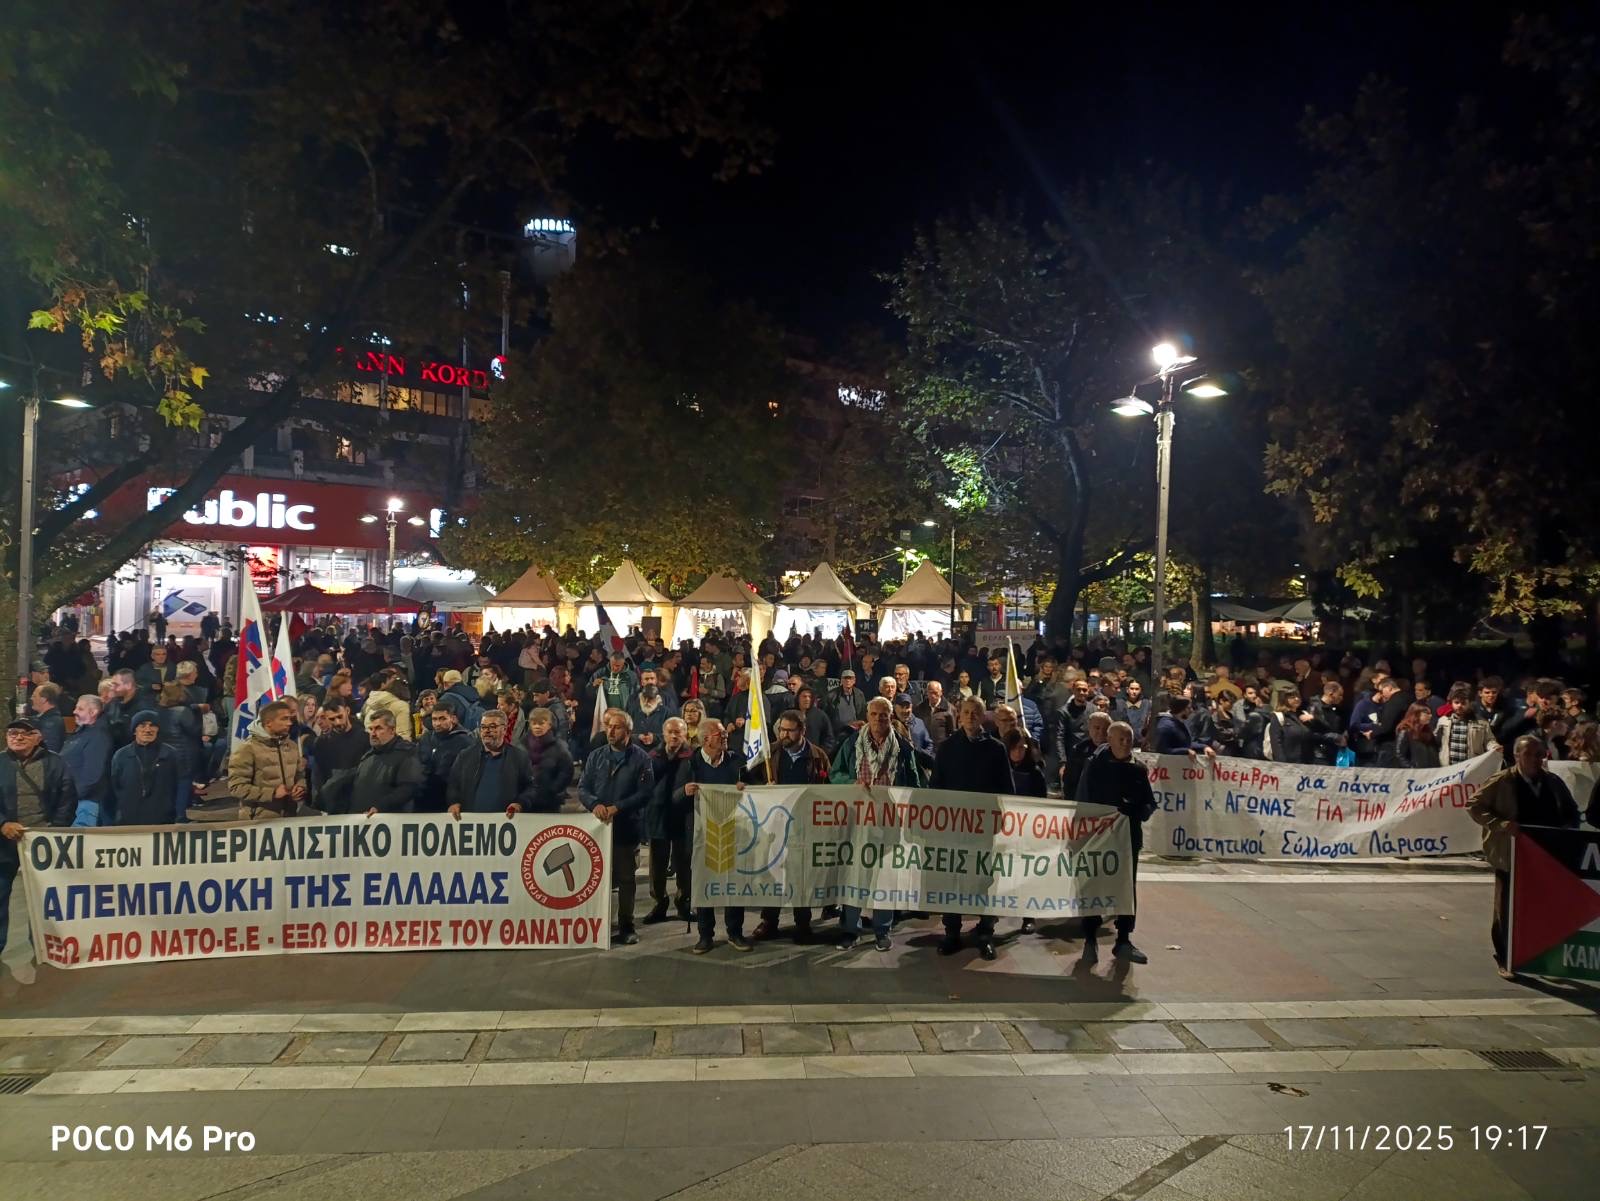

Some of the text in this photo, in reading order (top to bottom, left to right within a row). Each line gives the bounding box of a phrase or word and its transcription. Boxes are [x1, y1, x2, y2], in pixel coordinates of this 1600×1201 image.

[1183, 767, 1204, 781] του
[1296, 775, 1327, 791] για
[1339, 775, 1390, 794] πάντα
[812, 800, 848, 826] ΕΞΩ
[854, 801, 876, 827] ΤΑ
[992, 809, 1028, 837] ΤΟΥ
[1225, 790, 1296, 817] ΑΓΩΝΑΣ
[1317, 798, 1343, 823] ΓΙΑ
[1353, 798, 1386, 822] ΤΗΝ
[1393, 783, 1481, 815] ΑΝΑΤΡΟΠ
[31, 822, 517, 871] ΟΧΙ ΣΤΟΝ ΙΜΠΕΡΙΑΛΙΣΤΙΚΟ ΠΟΛΕΜΟ
[566, 828, 598, 854] ΚΕΝΤΡΟ
[812, 841, 1119, 877] ΕΞΩ ΟΙ ΒΑΣΕΙΣ ΚΑΙ ΤΟ ΝΑΤΟ
[1172, 826, 1449, 858] Φοιτητικοί Σύλλογοι Λάρισας
[43, 872, 509, 921] ΑΠΕΜΠΛΟΚΗ ΤΗΣ ΕΛΛΑΔΑΣ
[576, 867, 600, 902] ΛΑΡΙΣΑΣ
[815, 886, 918, 904] ΕΠΙΤΡΟΠΗ
[926, 890, 1018, 910] ΕΙΡΗΝΗΣ
[1026, 896, 1116, 911] ΛΑΡΙΣΑΣ
[44, 934, 79, 963] ΕΞΩ
[88, 931, 141, 963] ΑΠΟ
[282, 921, 327, 949] ΕΞΩ
[334, 921, 357, 948] ΟΙ
[365, 920, 442, 948] ΒΑΣΕΙΣ
[449, 919, 493, 947] ΤΟΥ
[500, 917, 603, 945] ΘΑΝΑΤΟΥ
